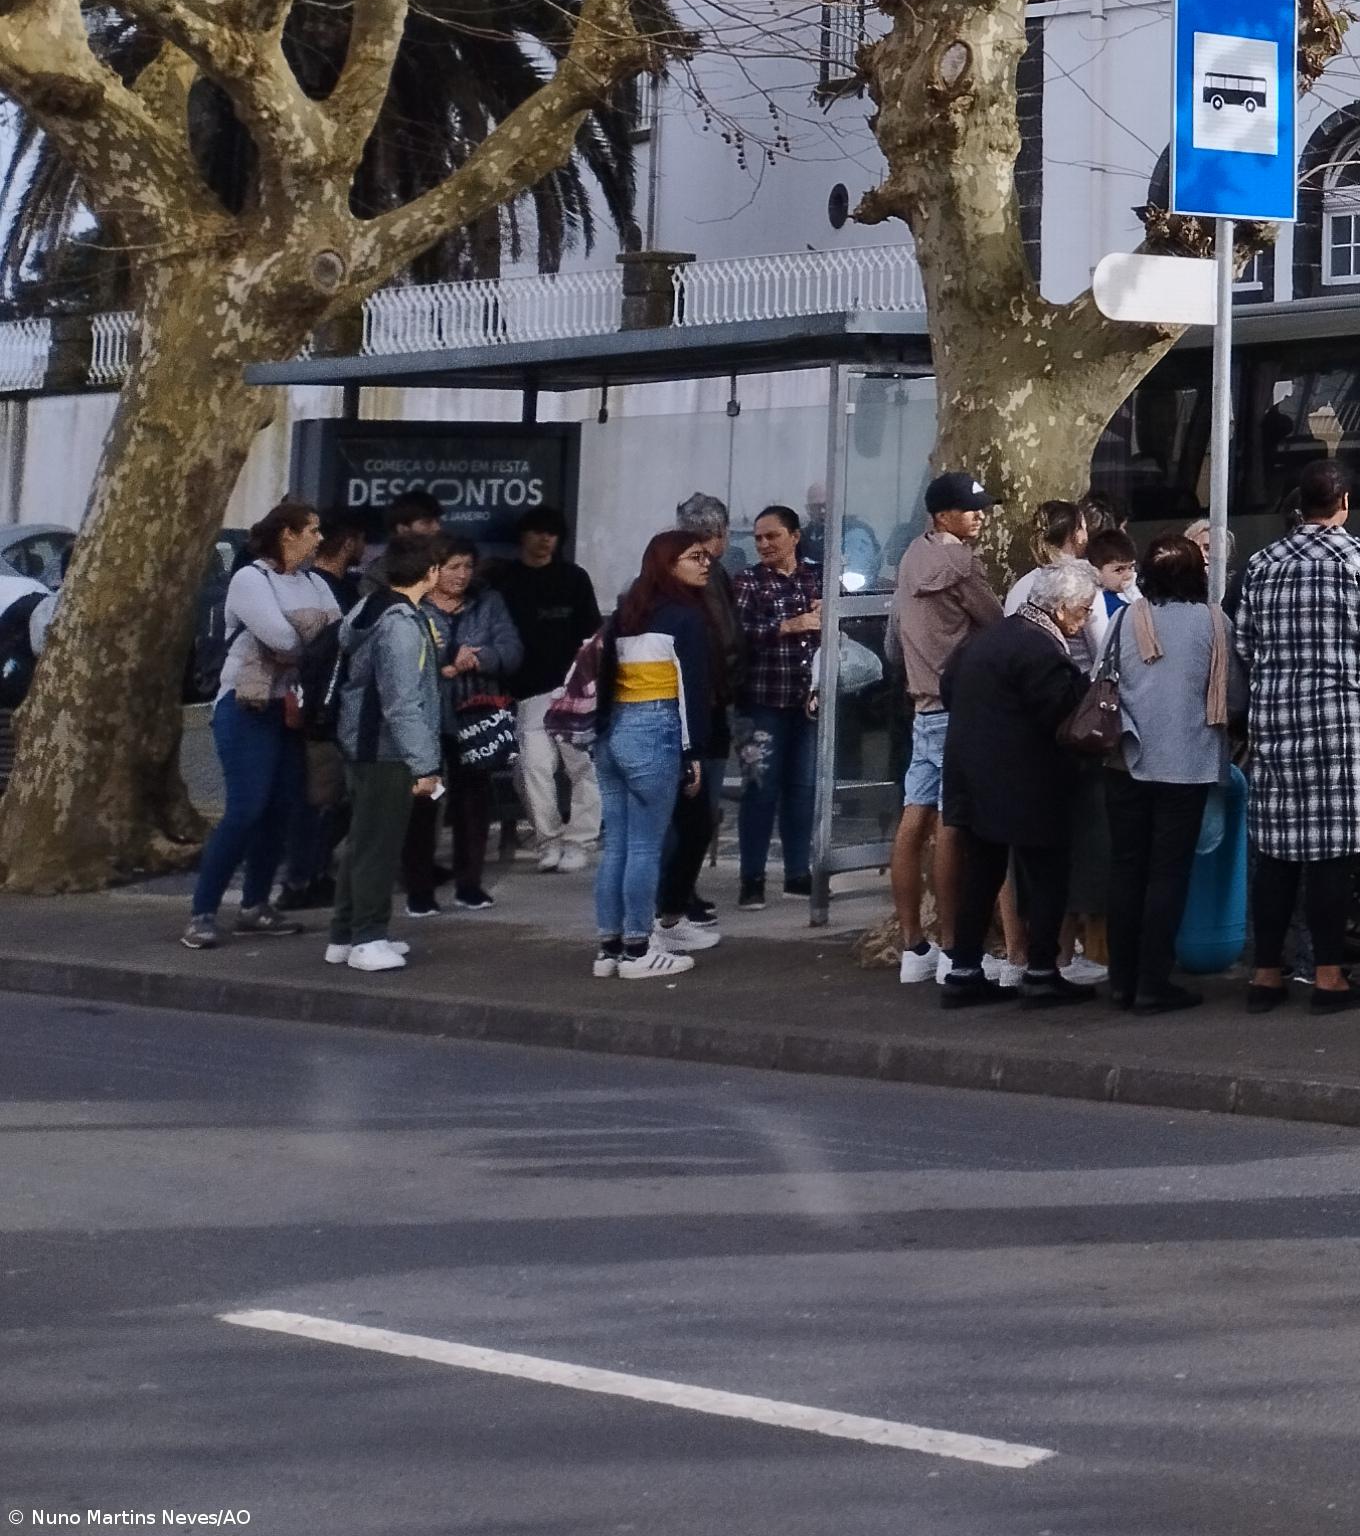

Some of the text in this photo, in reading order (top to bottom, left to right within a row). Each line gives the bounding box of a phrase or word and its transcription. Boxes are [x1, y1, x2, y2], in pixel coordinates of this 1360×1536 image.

[438, 460, 469, 473] ANO
[471, 460, 490, 473] EM
[492, 460, 530, 474] FESTA
